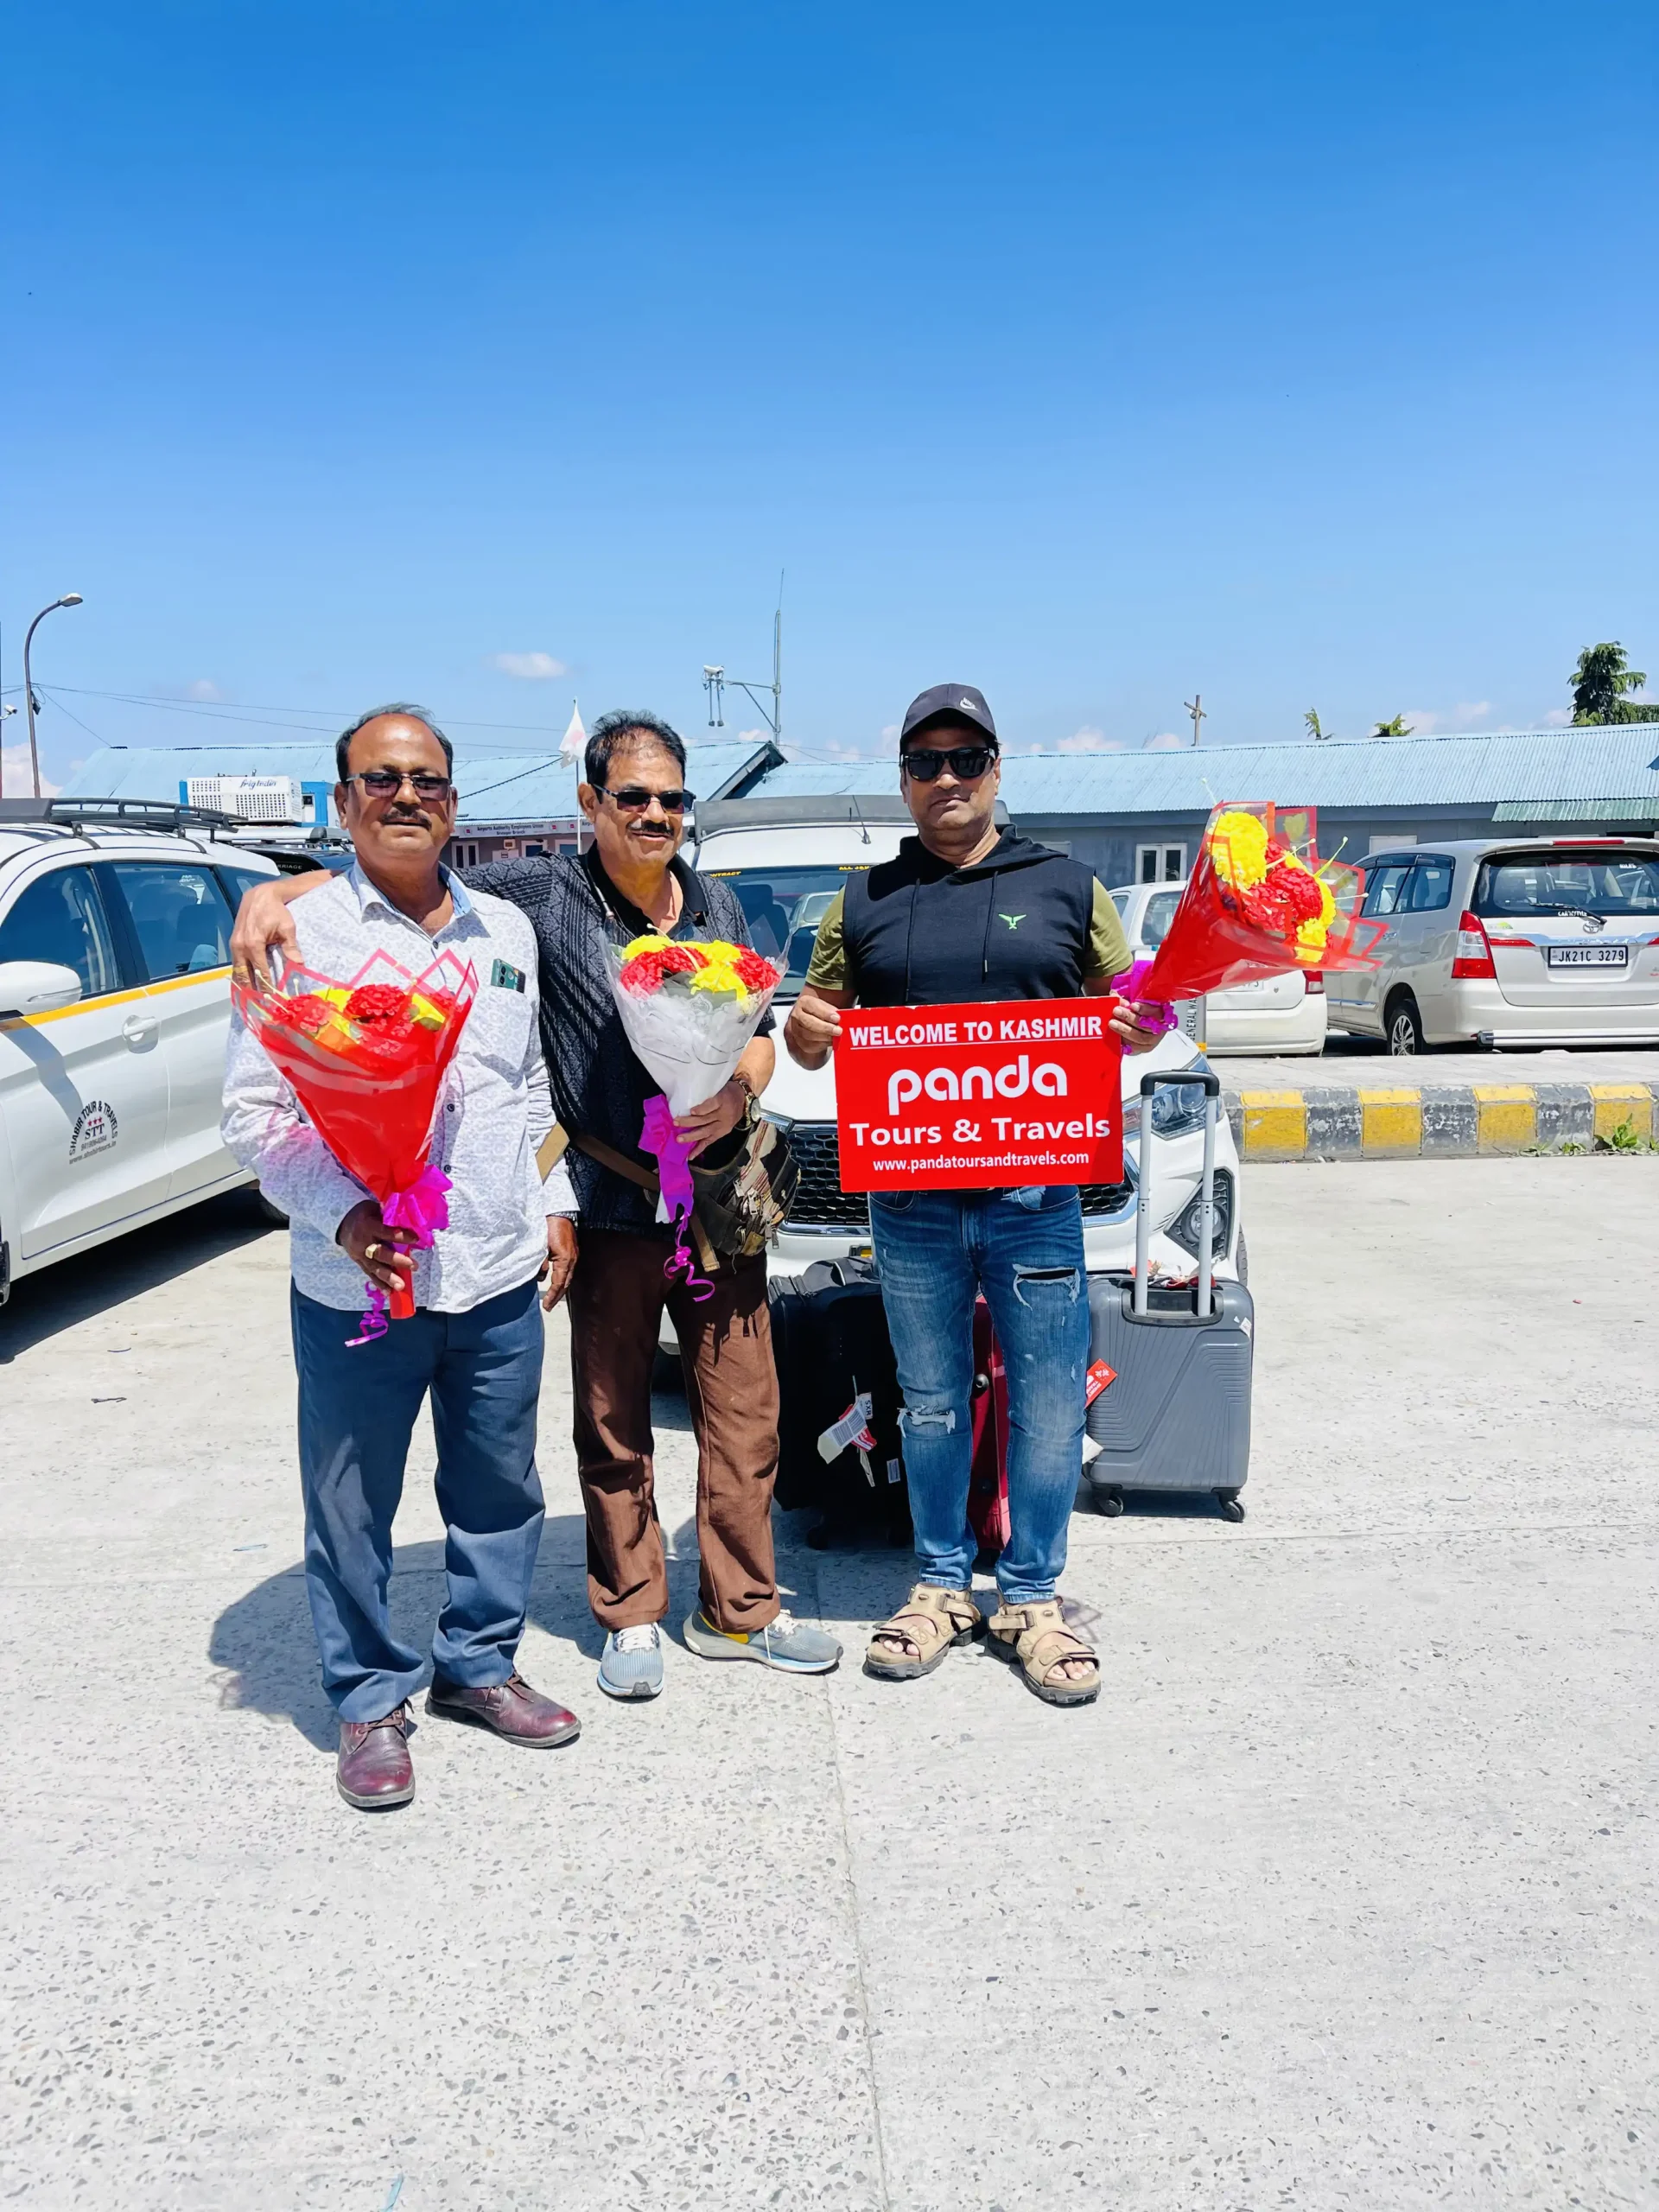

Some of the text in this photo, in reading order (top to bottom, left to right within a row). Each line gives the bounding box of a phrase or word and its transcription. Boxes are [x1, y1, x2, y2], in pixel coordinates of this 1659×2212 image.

[1559, 950, 1592, 962] JK21C
[1599, 950, 1624, 961] 3279
[849, 1016, 1102, 1046] WELCOME TO KASHMIR
[887, 1054, 1067, 1116] panda
[69, 1100, 118, 1155] SHABIR TOUR & TRAVELS
[85, 1123, 105, 1139] STT
[849, 1113, 1110, 1147] Tours & Travels
[873, 1150, 1089, 1173] www.pandatoursandtravels.com
